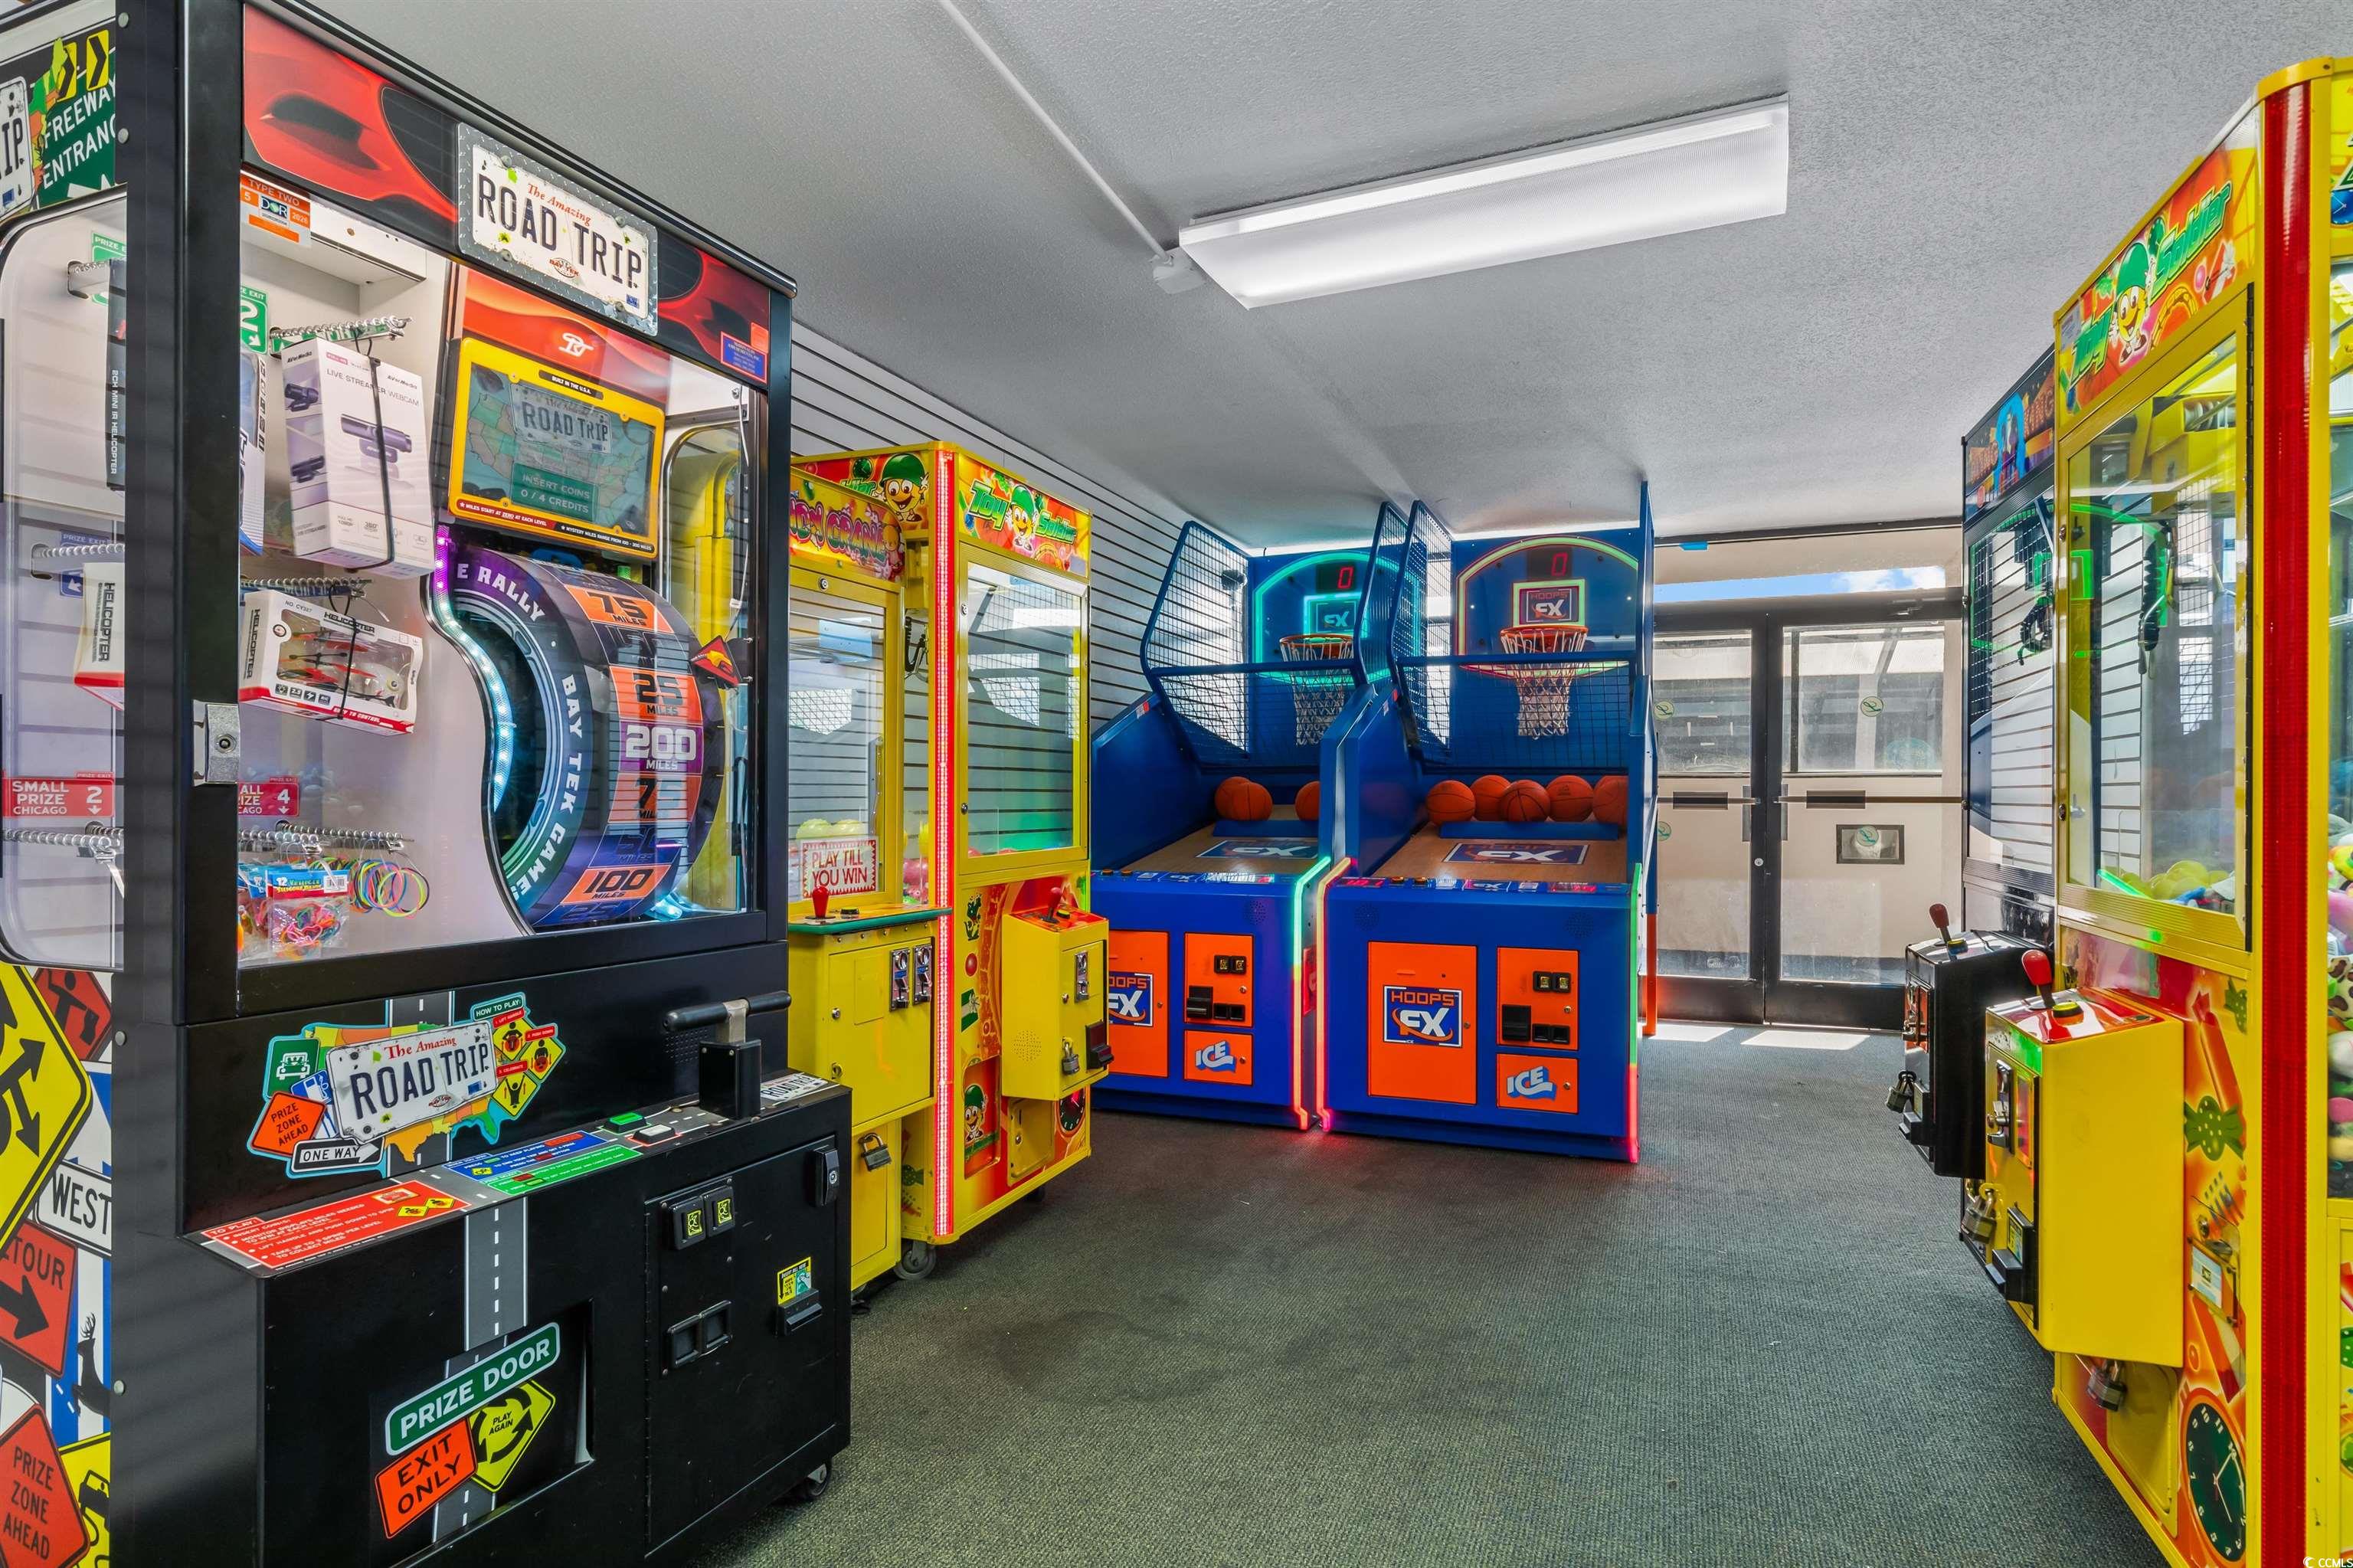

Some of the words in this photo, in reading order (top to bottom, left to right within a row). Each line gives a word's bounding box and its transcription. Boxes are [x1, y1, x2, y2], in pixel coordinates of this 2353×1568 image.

[247, 178, 275, 196] TYPE
[277, 190, 300, 207] TWO
[528, 183, 546, 201] The
[547, 196, 593, 228] Amazing
[477, 172, 558, 253] ROAD
[572, 221, 643, 290] TRIP
[95, 236, 119, 250] PRIZE
[249, 286, 265, 301] EXIT
[2068, 306, 2113, 393] Toy
[2148, 183, 2233, 304] Soldier
[326, 368, 345, 381] LIVE
[345, 375, 387, 395] STREAER
[388, 390, 420, 407] WEBCAM
[522, 401, 574, 436] ROAD
[110, 421, 119, 474] HELICOPTER
[522, 473, 558, 491] INSERT
[561, 485, 590, 499] COINS
[465, 503, 480, 512] MILES
[480, 506, 495, 515] START
[521, 516, 535, 524] EACH
[538, 494, 545, 502] 4
[548, 496, 589, 514] CREDITS
[968, 480, 1011, 532] Toy
[1035, 509, 1078, 545] Soldier
[63, 534, 86, 542] PRIZE
[566, 526, 584, 535] MYSTERY
[584, 530, 597, 538] MILES
[610, 535, 622, 545] FROM
[1551, 552, 1568, 576] 0
[1337, 565, 1354, 589] 0
[477, 566, 545, 622] RALLY
[586, 591, 647, 619] 75
[98, 582, 116, 662] HELICOPTER
[613, 614, 646, 626] MILES
[246, 608, 261, 679] HELICOPTER
[633, 673, 683, 705] 25
[562, 674, 582, 738] BAY
[647, 704, 679, 715] MILES
[357, 712, 381, 723] CONTROL
[625, 725, 696, 761] 200
[646, 759, 678, 771] MILES
[12, 781, 69, 793] SMALL
[240, 784, 264, 795] ALL
[560, 753, 582, 814] TEK
[17, 794, 65, 805] PRIZE
[86, 786, 103, 804] 2
[277, 788, 290, 804] 4
[13, 807, 67, 815] CHICAGO
[812, 851, 839, 868] PLAY
[842, 849, 863, 866] TILL
[584, 869, 653, 893] 100
[812, 869, 839, 888] YOU
[843, 866, 868, 885] WIN
[591, 891, 626, 899] MILES
[1391, 990, 1455, 1007] HOOPS
[476, 1007, 492, 1016] HOW
[385, 1044, 413, 1060] The
[415, 1036, 458, 1054] Amazing
[1195, 1040, 1236, 1071] ICE
[349, 1057, 437, 1120] ROAD
[439, 1043, 489, 1086] TRIP
[761, 1082, 800, 1098] ROAD
[1507, 1066, 1555, 1098] ICE
[270, 1102, 299, 1122] PRIZE
[276, 1114, 303, 1134] ZONE
[277, 1123, 309, 1147] AHEAD
[303, 1149, 330, 1162] ONE
[334, 1146, 361, 1158] WAY
[52, 1173, 113, 1235] WEST
[241, 1228, 277, 1242] MONITOR
[308, 1227, 324, 1236] AND
[270, 1247, 291, 1256] TAKE
[401, 1379, 475, 1439] PRIZE
[483, 1337, 550, 1393] DOOR
[493, 1411, 512, 1425] PLAY
[2201, 1406, 2210, 1423] 10
[2214, 1417, 2224, 1434] 11
[489, 1419, 514, 1435] AGAIN
[14, 1445, 54, 1492] PRIZE
[398, 1433, 452, 1488] EXIT
[397, 1453, 461, 1514] ONLY
[2190, 1471, 2197, 1480] 7
[11, 1480, 49, 1525] ZONE
[3, 1512, 51, 1561] AHEAD
